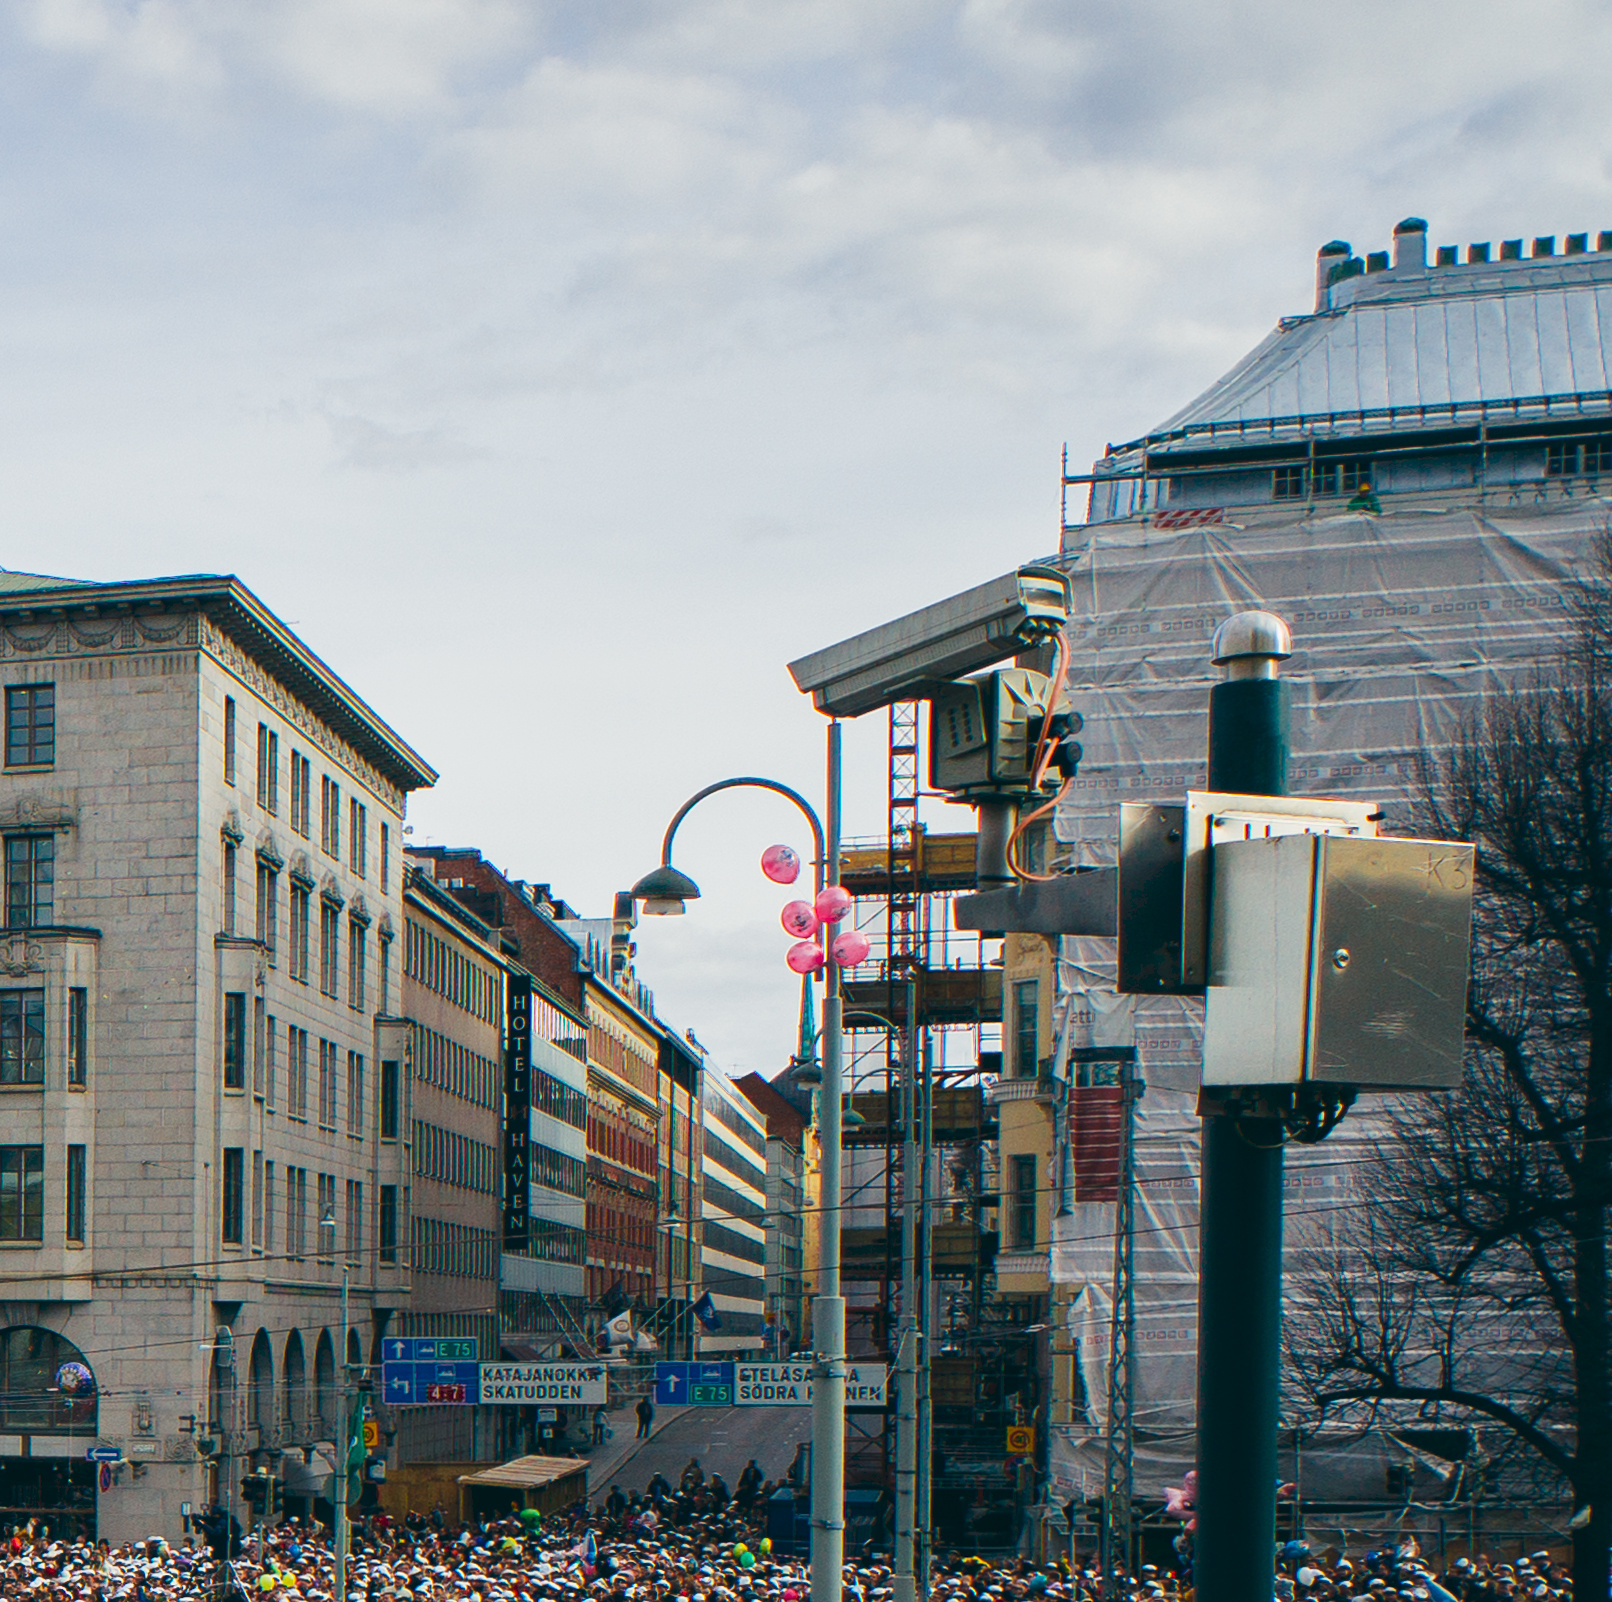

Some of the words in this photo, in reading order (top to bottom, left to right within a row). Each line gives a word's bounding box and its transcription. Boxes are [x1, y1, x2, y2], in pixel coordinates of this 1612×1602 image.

[513, 996, 526, 1092] HOTEL
[511, 1133, 524, 1228] HAVEN
[440, 1343, 448, 1356] E
[453, 1343, 471, 1356] 75
[482, 1368, 599, 1382] KATAJANOKKA
[483, 1385, 582, 1399] SKATUDDEN
[694, 1387, 702, 1400] E
[709, 1387, 727, 1400] 75
[740, 1384, 798, 1400] SÖDRA
